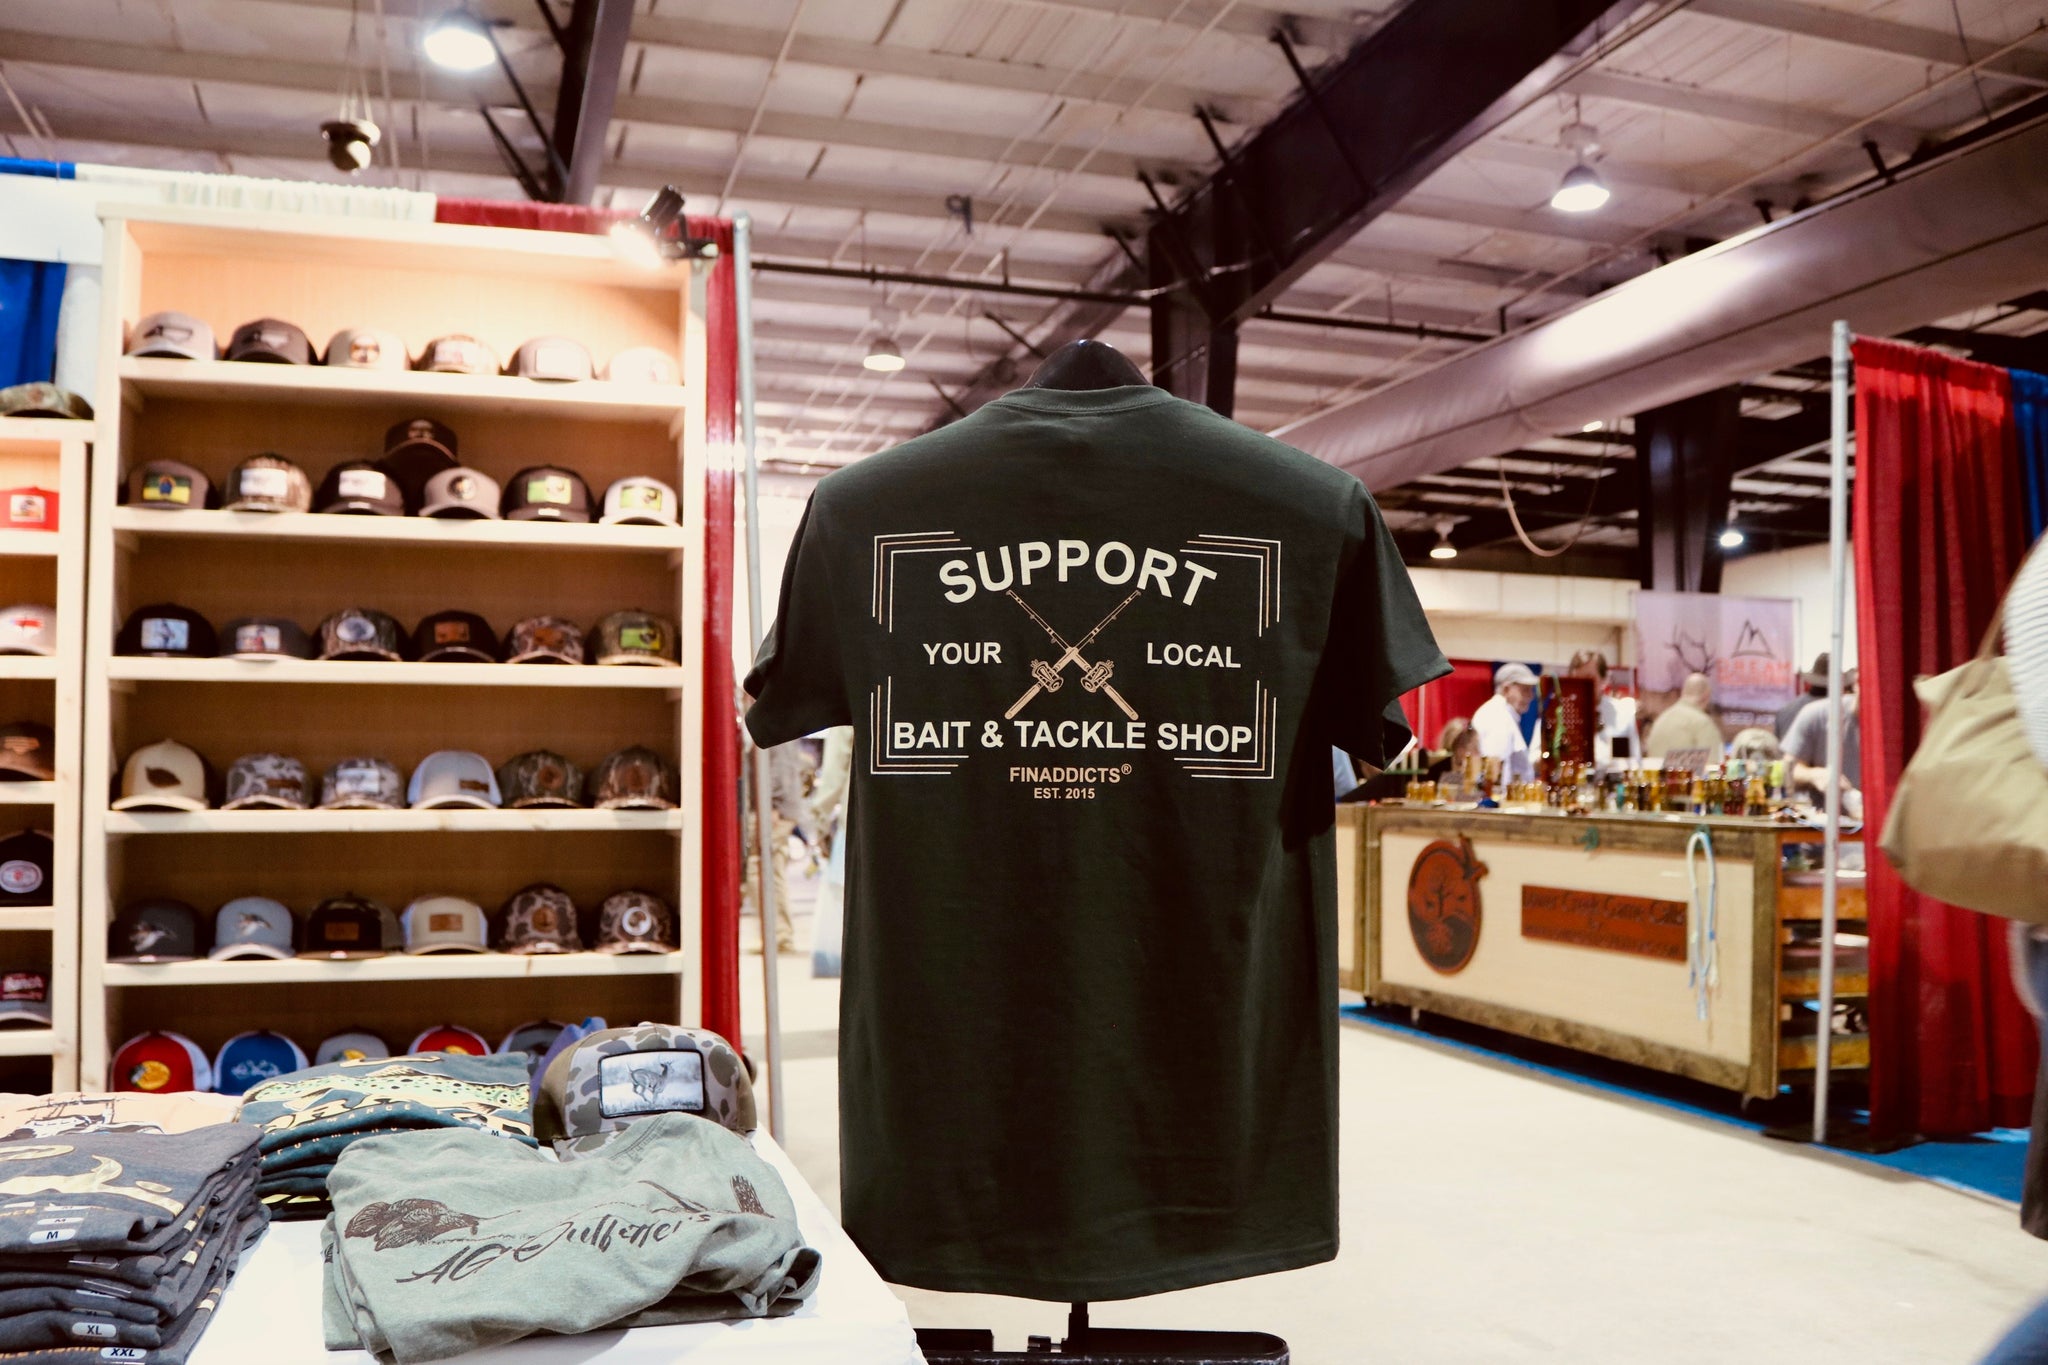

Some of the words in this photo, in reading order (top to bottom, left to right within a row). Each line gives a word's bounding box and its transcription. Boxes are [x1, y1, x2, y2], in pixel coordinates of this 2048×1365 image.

[938, 539, 1217, 606] SUPPORT
[922, 642, 1002, 665] YOUR
[1146, 642, 1241, 668] LOCAL
[894, 721, 971, 750] BAIT
[981, 721, 1004, 748] &
[1014, 720, 1146, 750] TACKLE
[1157, 722, 1253, 752] SHOP
[1033, 787, 1062, 799] EST.
[1065, 787, 1095, 799] 2015
[46, 1231, 59, 1240] M
[87, 1324, 102, 1335] XL
[110, 1348, 135, 1357] XXL
